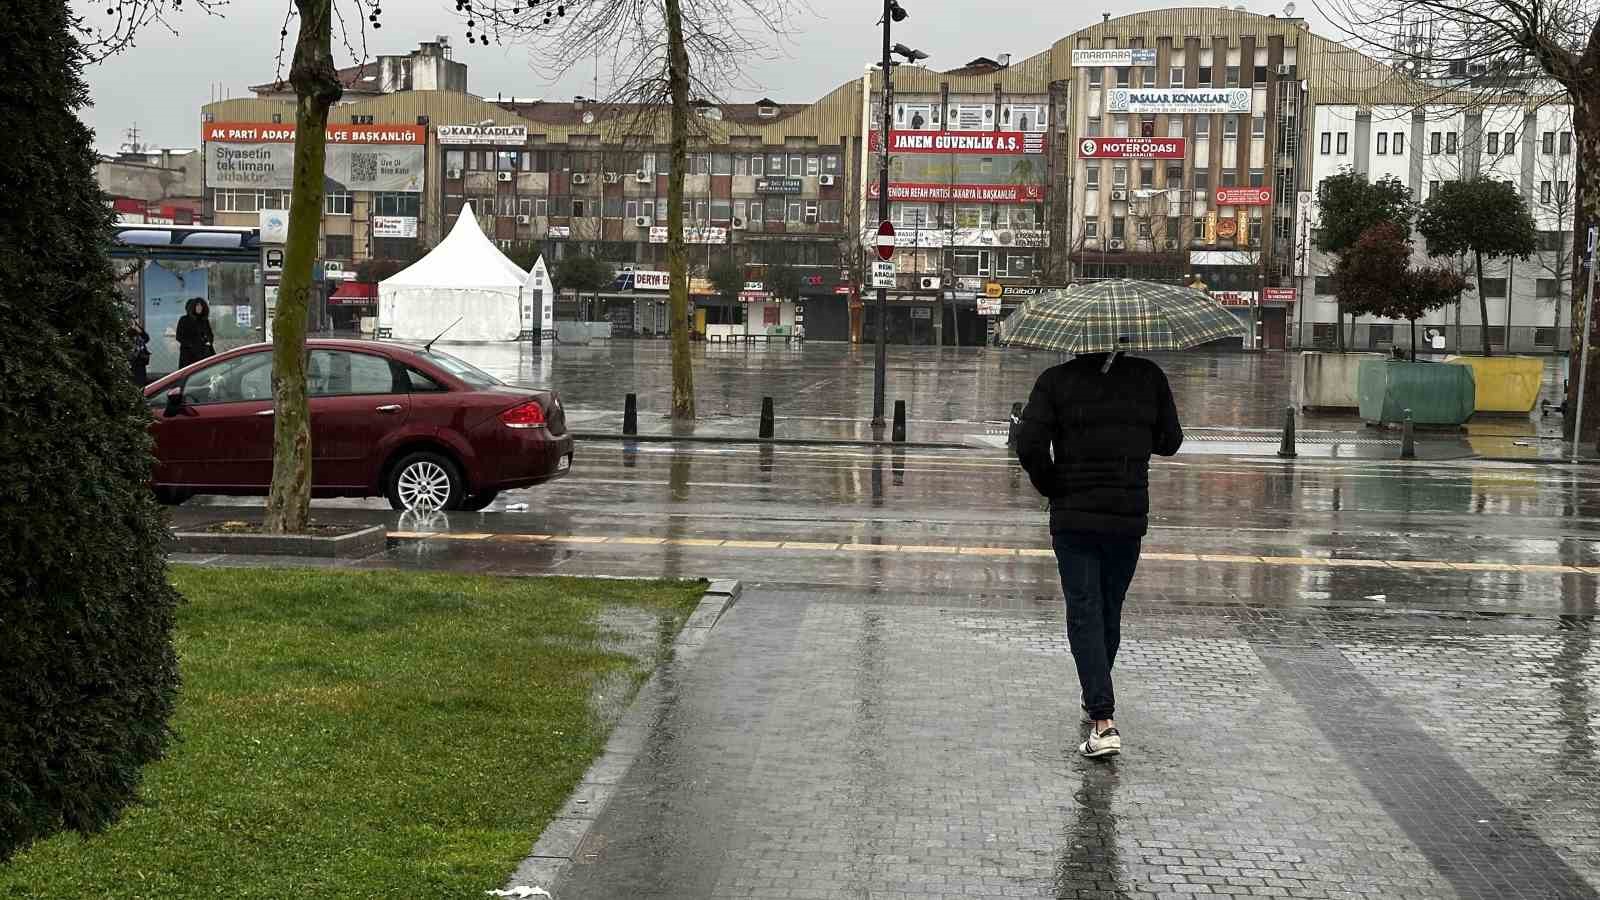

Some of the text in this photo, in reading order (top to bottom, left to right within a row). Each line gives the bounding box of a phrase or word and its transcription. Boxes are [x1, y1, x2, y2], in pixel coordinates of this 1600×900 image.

[1080, 51, 1131, 60] MARMARA
[1171, 94, 1230, 104] KONAKLARI
[211, 129, 225, 139] AK
[228, 128, 257, 139] PARTİ
[261, 129, 296, 140] ADAPA
[352, 129, 416, 142] BAŞKANLIĞI
[451, 127, 525, 137] KARAKADILAR
[894, 135, 934, 149] JANEM
[935, 133, 994, 149] GÜVENLİK
[996, 135, 1020, 151] A.Ş.
[216, 147, 271, 160] Siyasetin
[1102, 143, 1176, 153] NOTER ODASI
[216, 160, 275, 172] tek limanı
[911, 187, 928, 198] REFAH
